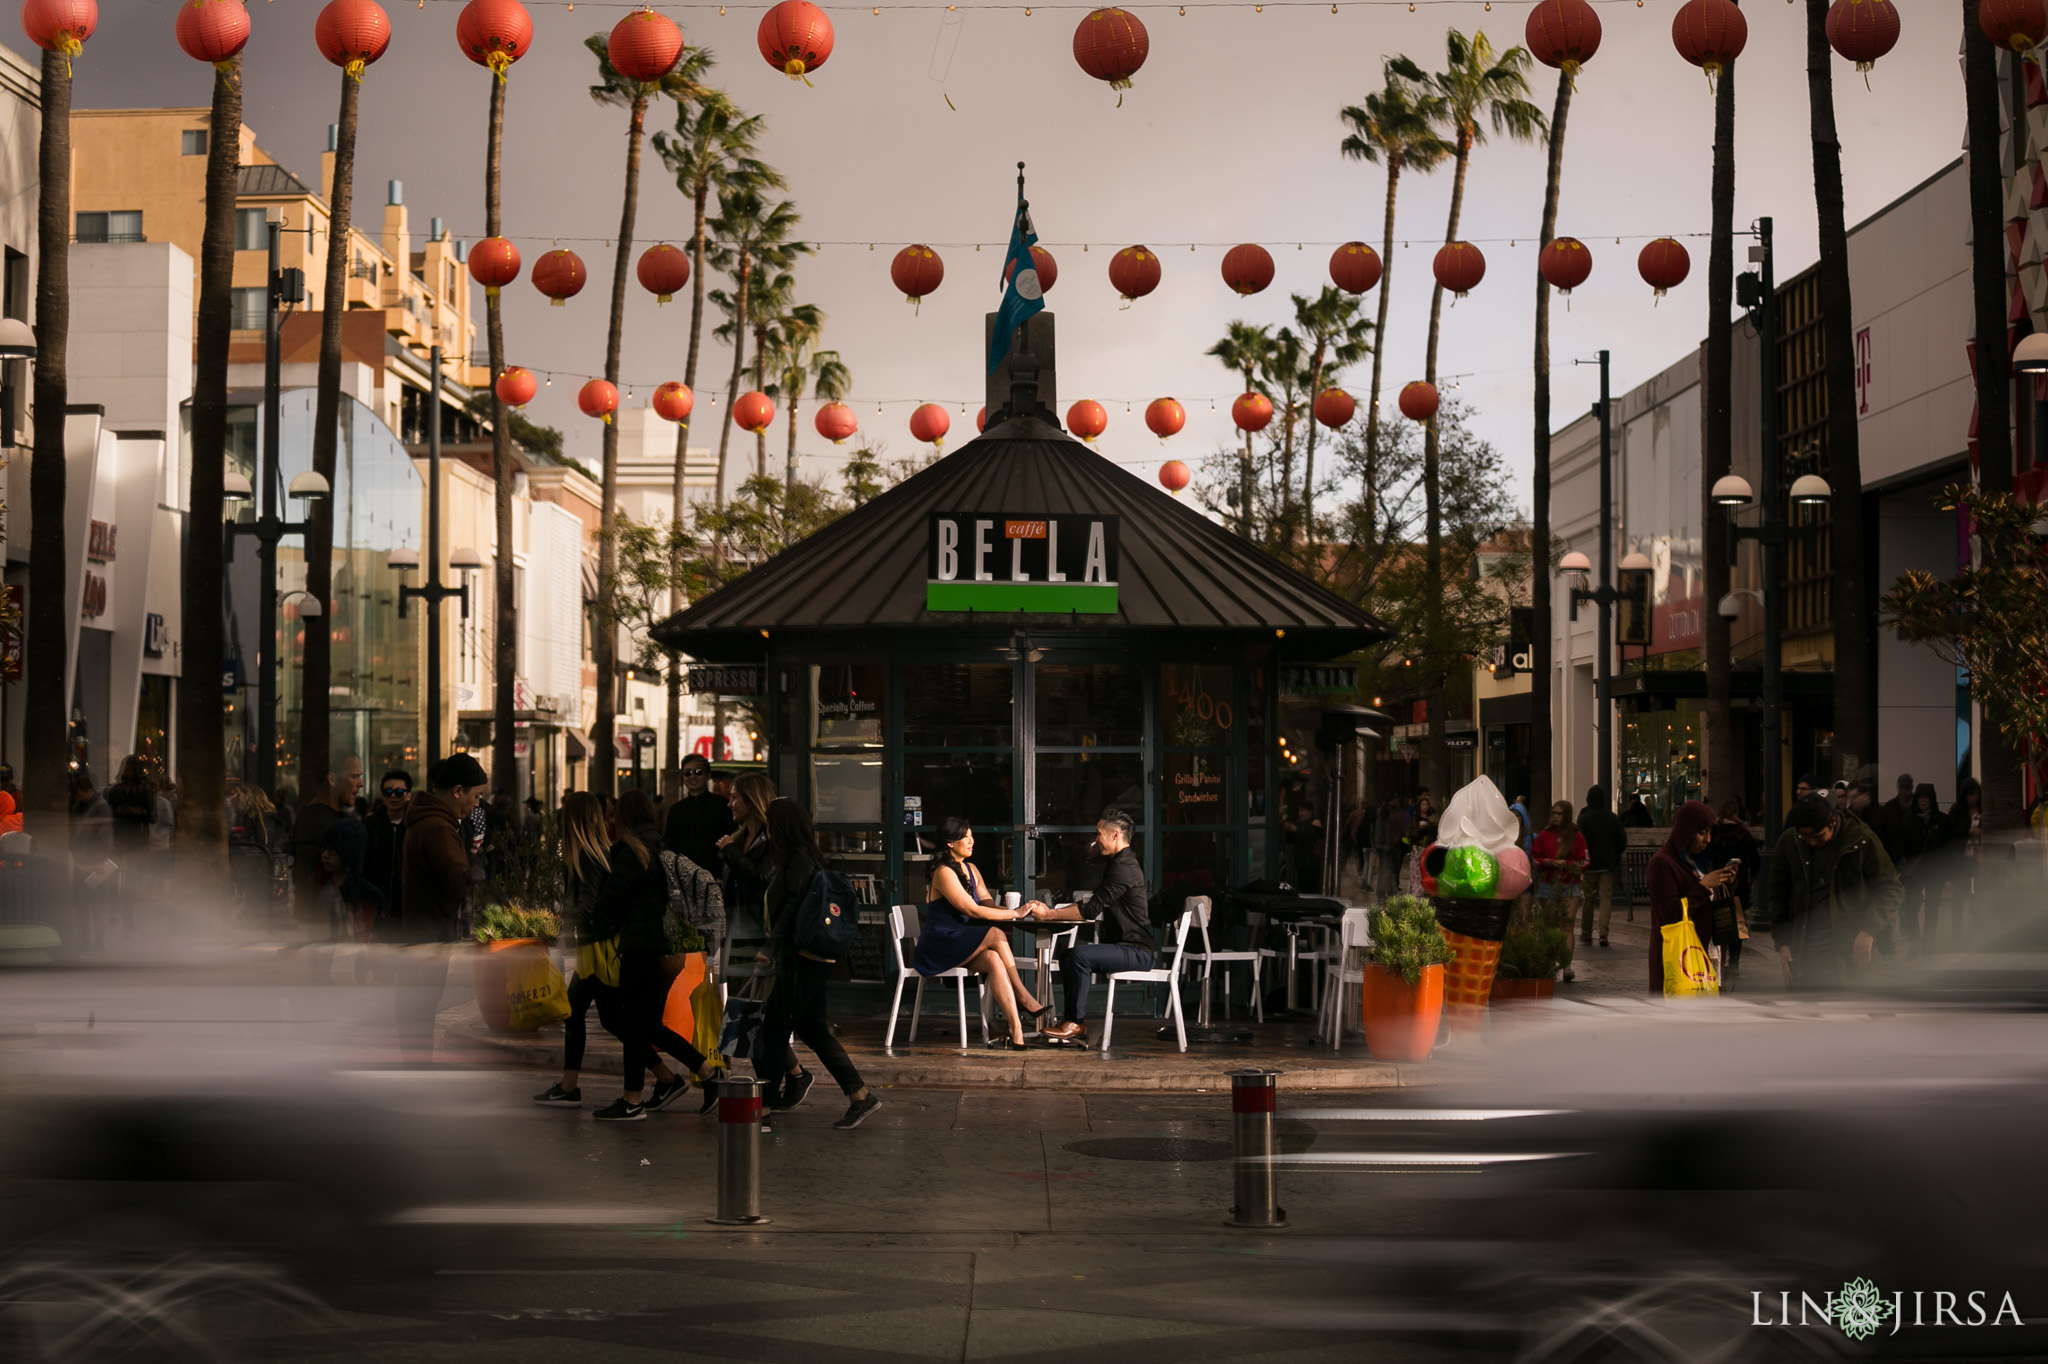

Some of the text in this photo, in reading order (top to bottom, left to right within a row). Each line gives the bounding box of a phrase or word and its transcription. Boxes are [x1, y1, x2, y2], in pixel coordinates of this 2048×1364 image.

[1008, 520, 1045, 539] caffé
[938, 519, 1108, 583] BELLA
[689, 668, 757, 689] ESPRESSO
[817, 699, 876, 715] Specialty Coffees
[1167, 669, 1233, 730] 1400
[1178, 790, 1219, 804] Sandwiches
